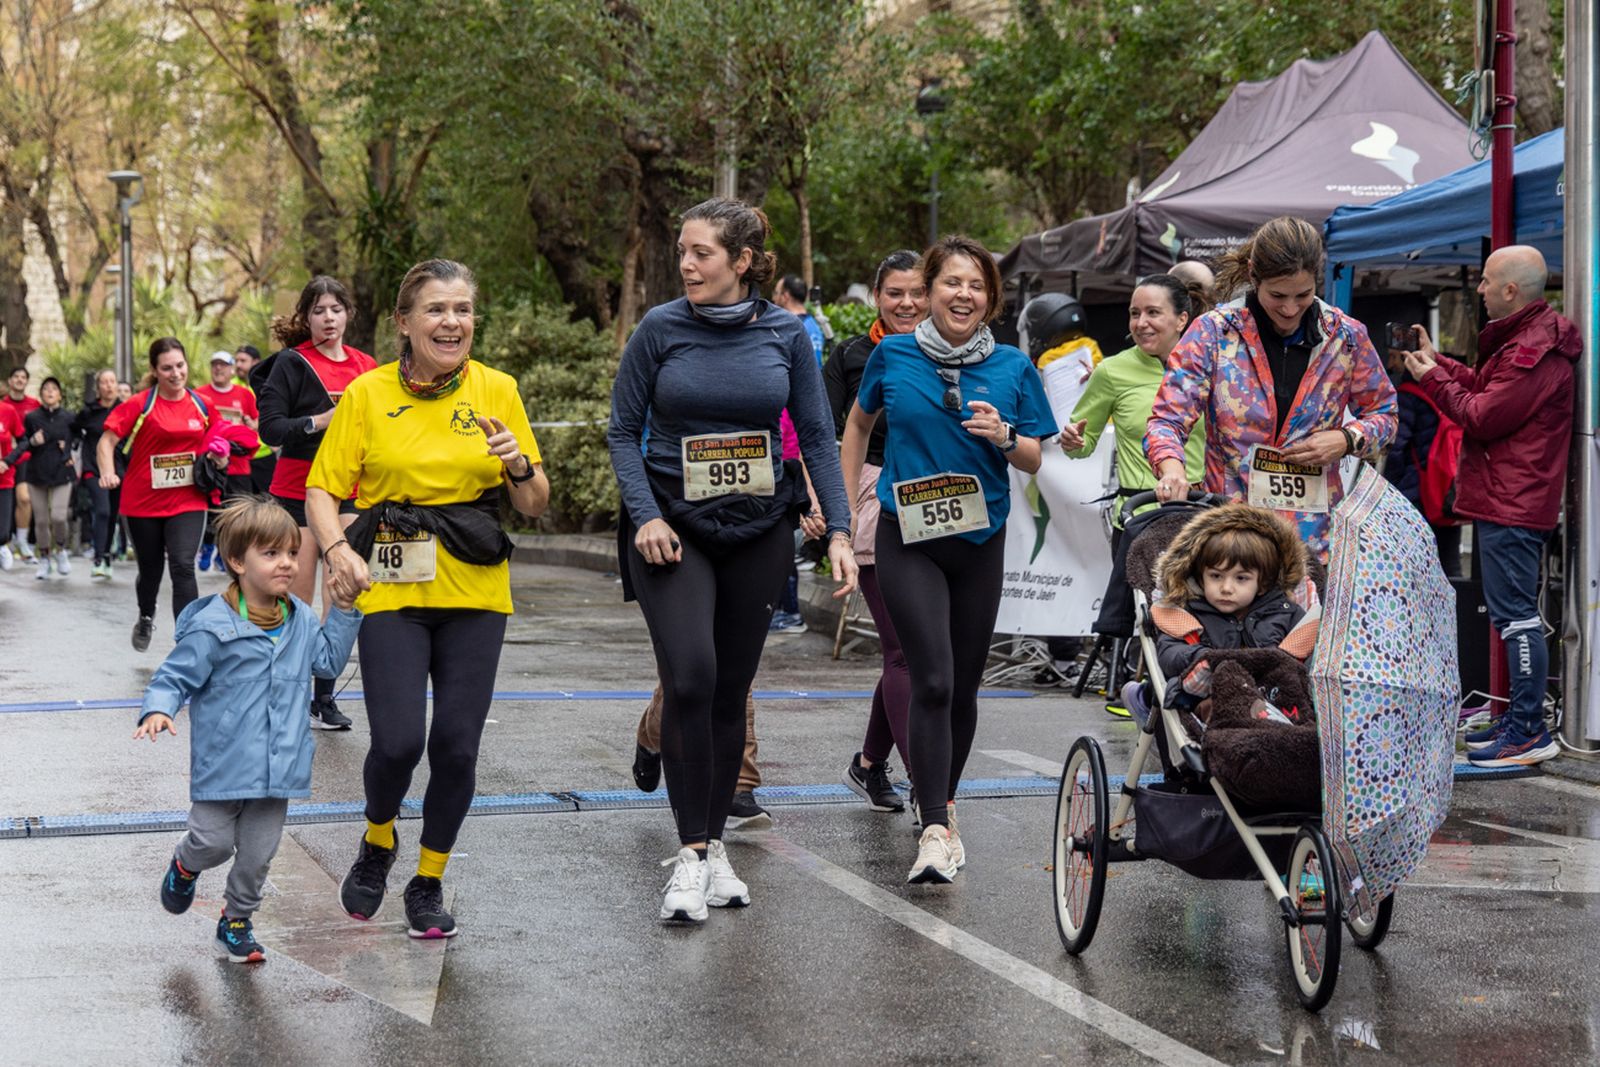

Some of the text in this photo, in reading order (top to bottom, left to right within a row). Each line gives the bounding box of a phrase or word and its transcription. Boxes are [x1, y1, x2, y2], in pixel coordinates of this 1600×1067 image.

[692, 437, 762, 450] IES San Juan Bosco
[689, 447, 765, 460] V CARRERA POPULAR
[164, 467, 186, 481] 720
[709, 461, 751, 486] 993
[901, 483, 976, 505] V CARRERA POPULAR
[902, 484, 914, 494] IES
[915, 482, 930, 492] San
[931, 478, 949, 488] Juan
[1269, 475, 1306, 498] 559
[922, 498, 963, 526] 556
[378, 545, 403, 569] 48
[1022, 570, 1061, 587] Municipal
[1061, 575, 1074, 587] de
[1024, 587, 1036, 600] de
[1036, 588, 1057, 601] Jaén
